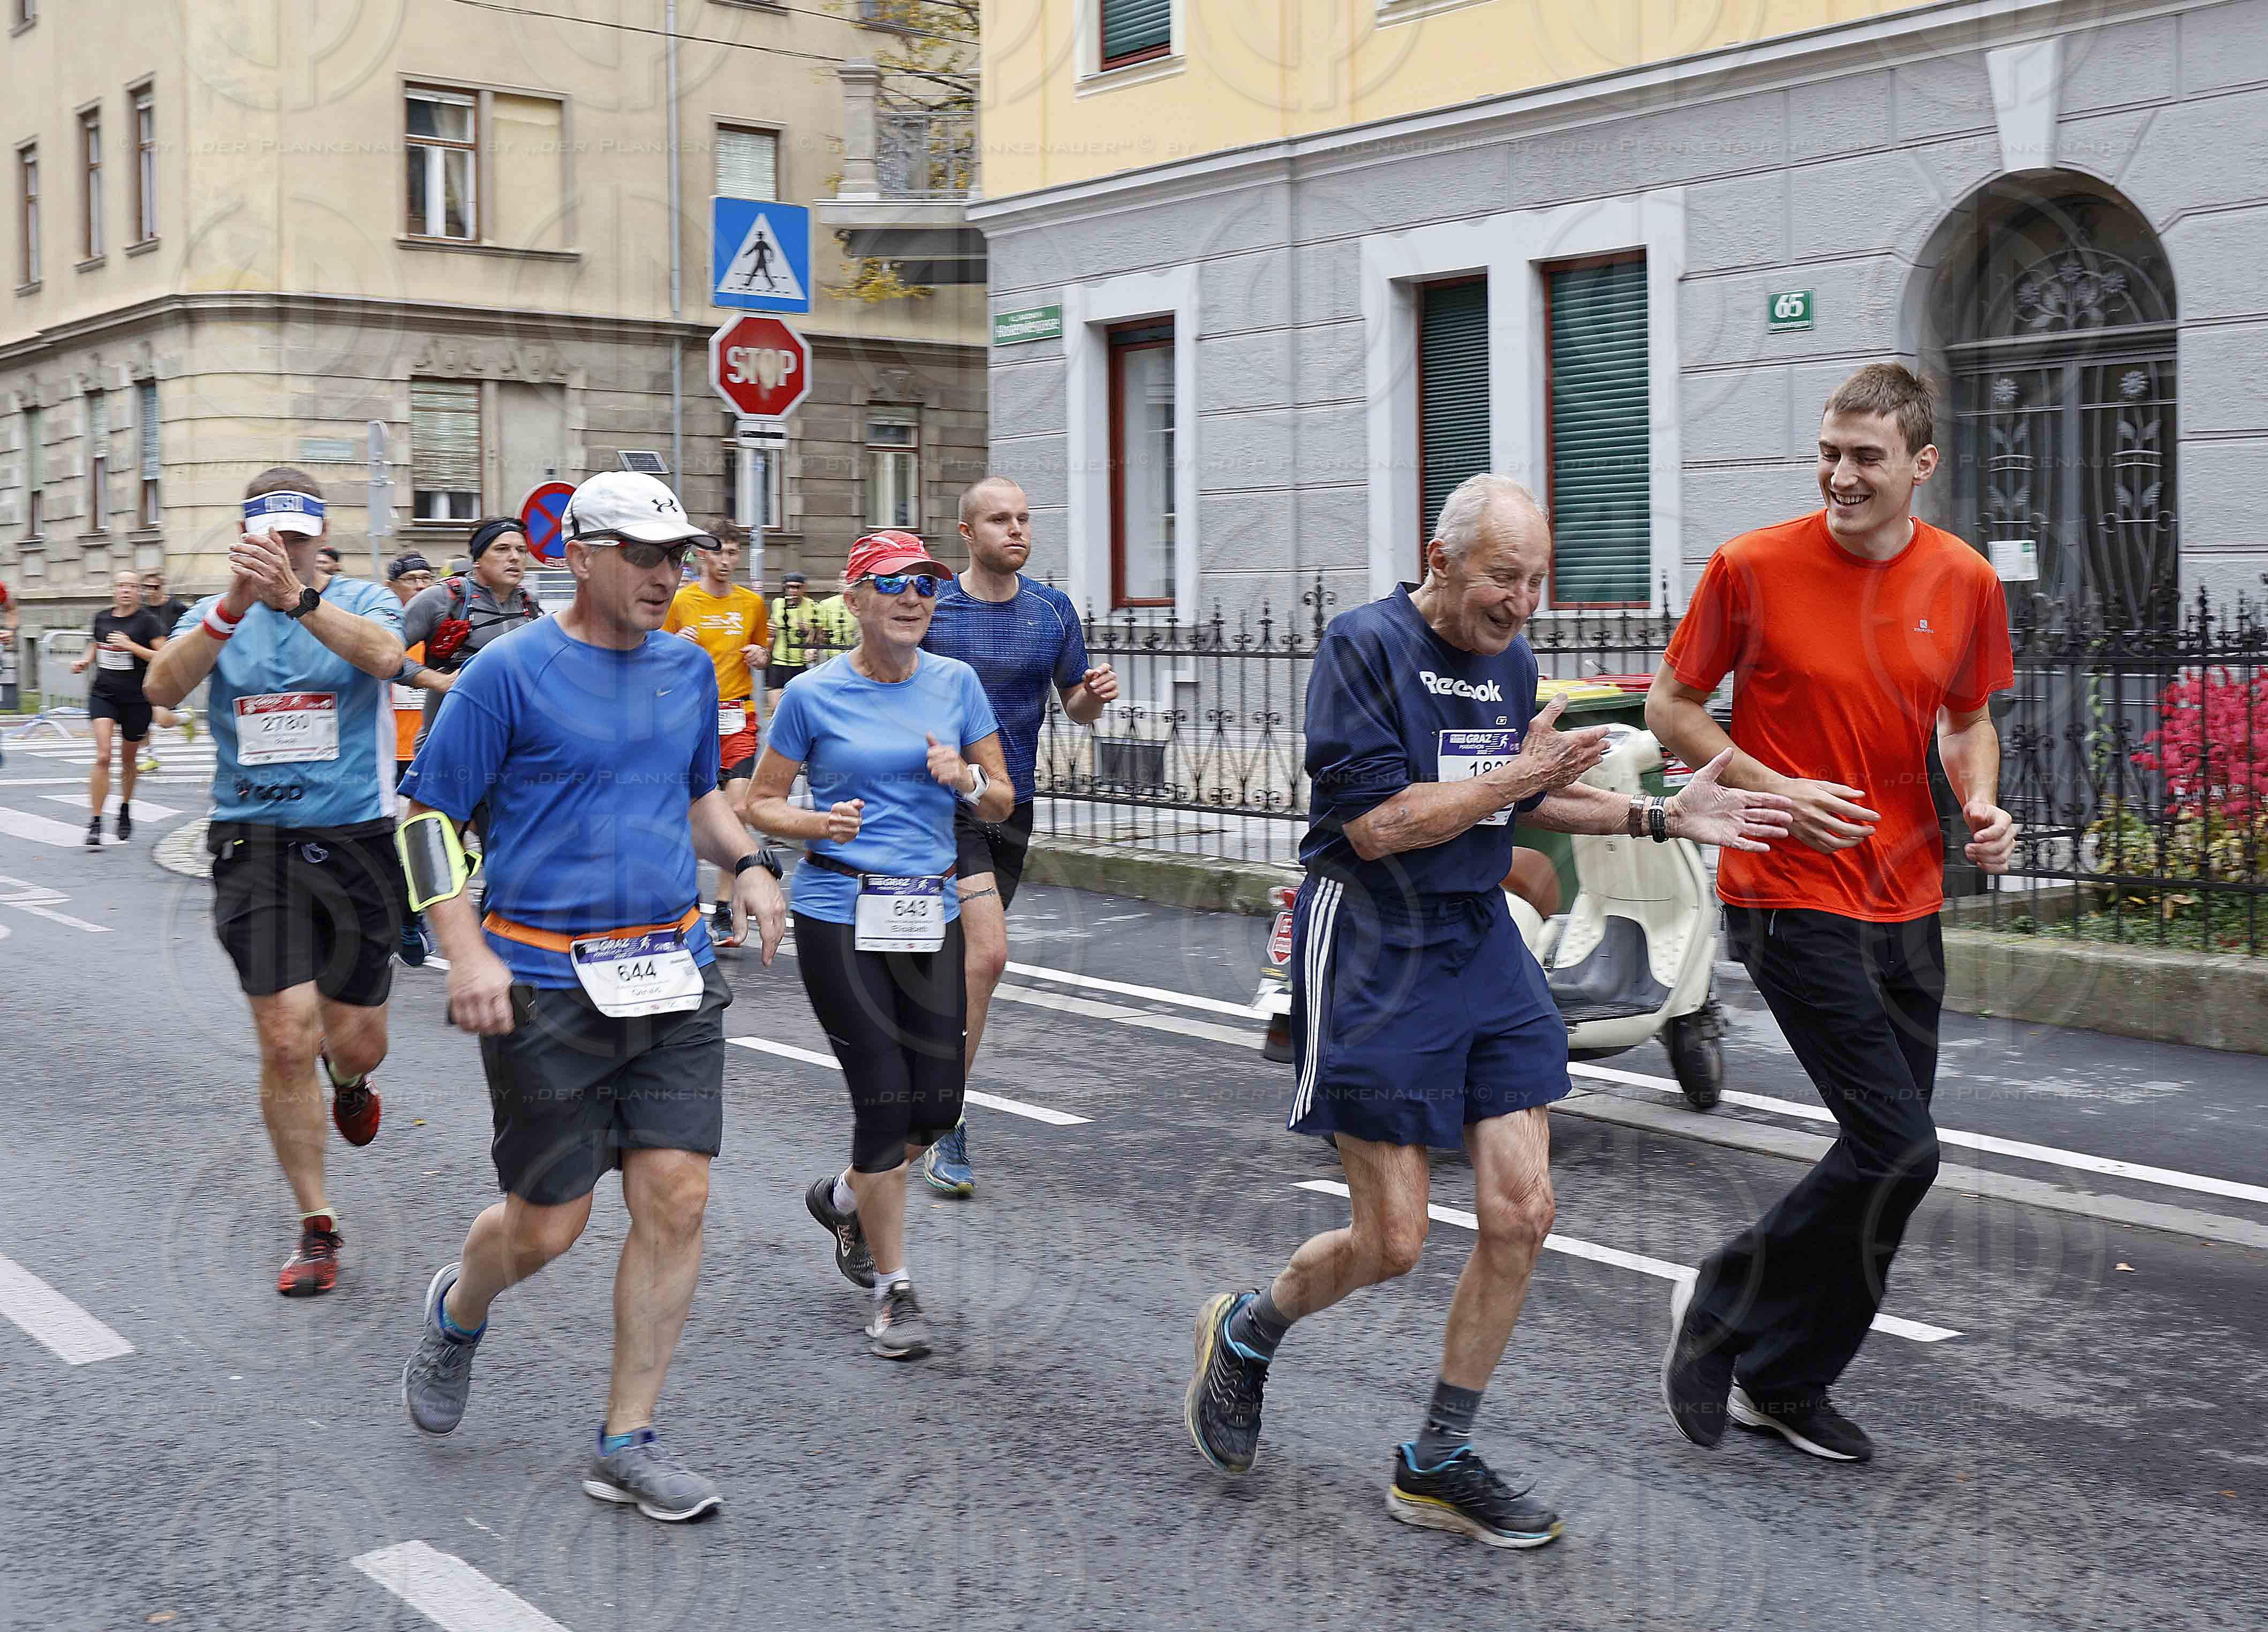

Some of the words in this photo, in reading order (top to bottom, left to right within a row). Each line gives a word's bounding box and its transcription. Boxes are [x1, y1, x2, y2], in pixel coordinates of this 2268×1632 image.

[1774, 293, 1804, 318] 65
[726, 345, 798, 387] STOP
[1466, 734, 1492, 743] GRAZ
[1469, 760, 1511, 776] 18
[895, 900, 927, 916] 643
[617, 961, 657, 981] 644
